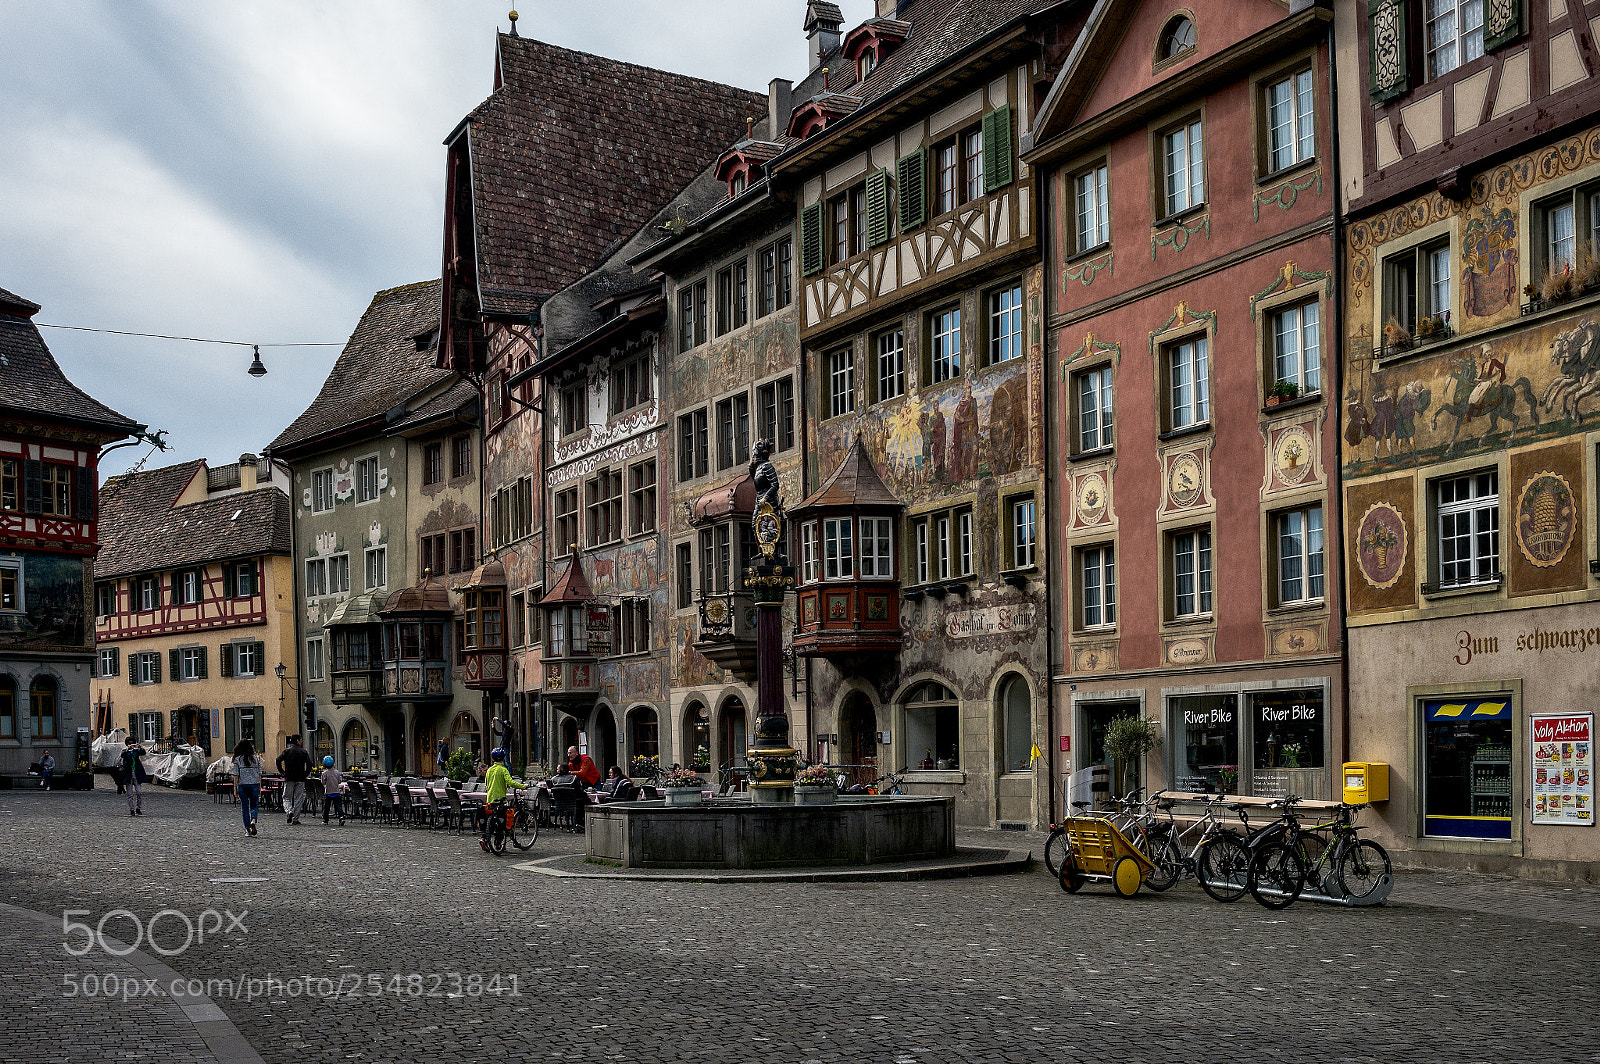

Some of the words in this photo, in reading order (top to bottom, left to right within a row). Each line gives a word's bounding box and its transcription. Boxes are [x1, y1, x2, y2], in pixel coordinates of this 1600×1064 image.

[1453, 630, 1499, 665] Zum
[1184, 710, 1210, 725] River
[1210, 708, 1232, 723] Bike
[1262, 706, 1290, 721] River
[1291, 704, 1316, 720] Bike
[1554, 718, 1589, 737] Aktion
